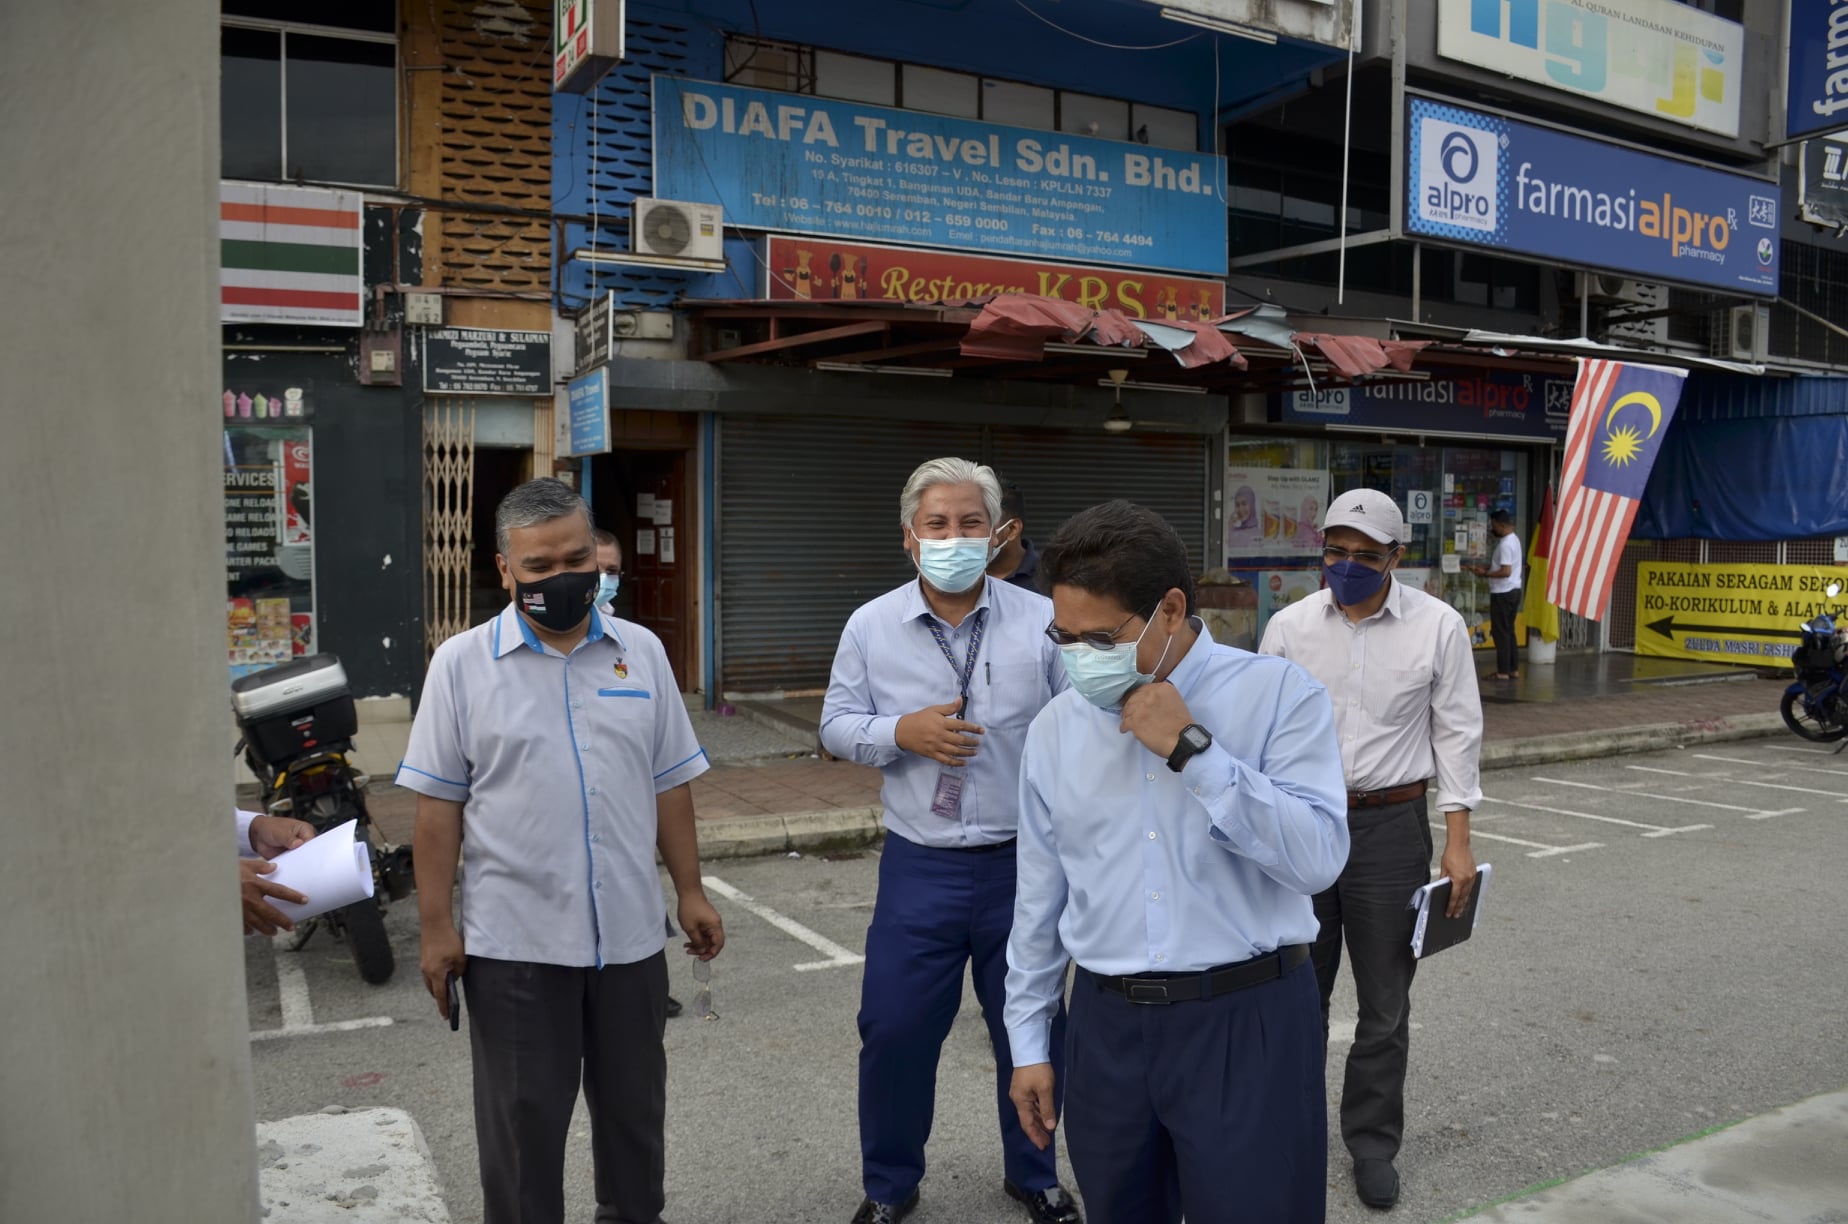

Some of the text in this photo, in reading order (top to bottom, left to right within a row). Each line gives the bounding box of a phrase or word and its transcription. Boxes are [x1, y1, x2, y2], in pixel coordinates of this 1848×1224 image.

[1585, 2, 1621, 19] QURAN
[1623, 12, 1672, 36] LANDASAN
[1674, 29, 1725, 52] KEHIDUPAN
[1812, 0, 1848, 116] farm
[681, 91, 1213, 196] DIAFA Travel Sdn. Bhd.
[805, 150, 827, 164] No.
[831, 153, 883, 169] Syarikat
[895, 161, 939, 177] 616307
[953, 167, 962, 180] V
[972, 170, 992, 184] No.
[995, 174, 1031, 188] Lesen
[1086, 184, 1112, 199] 7337
[842, 172, 883, 187] Tingkat
[899, 179, 954, 194] Bangunan
[986, 189, 1022, 202] Bandar
[1025, 194, 1048, 206] Baru
[1050, 197, 1105, 214] Ampangan,
[883, 190, 940, 206] Seremban,
[943, 197, 977, 210] Negeri
[1428, 182, 1489, 220] alpro
[1516, 162, 1636, 231] farmasi
[1637, 193, 1730, 258] alpro
[752, 193, 776, 206] Tel
[790, 197, 809, 210] 06
[824, 201, 852, 214] 764
[857, 204, 892, 218] 0010
[904, 209, 931, 223] 012
[945, 214, 971, 227] 659
[975, 217, 1008, 231] 0000
[1032, 223, 1056, 237] Fax
[1067, 227, 1083, 239] 06
[1096, 230, 1119, 243] 764
[1122, 233, 1153, 247] 4494
[1679, 244, 1726, 266] pharmacy
[1456, 377, 1529, 418] alpro
[1488, 408, 1526, 420] pharmacy
[222, 471, 275, 487] ERVICES
[1410, 511, 1431, 522] alpro
[1648, 571, 1711, 588] PAKAIAN
[1716, 573, 1793, 591] SERAGAM
[1644, 595, 1762, 616] KO-KORIKULUM
[1767, 601, 1779, 616] &
[1784, 601, 1826, 618] ALAT
[1725, 639, 1761, 655] MASRI
